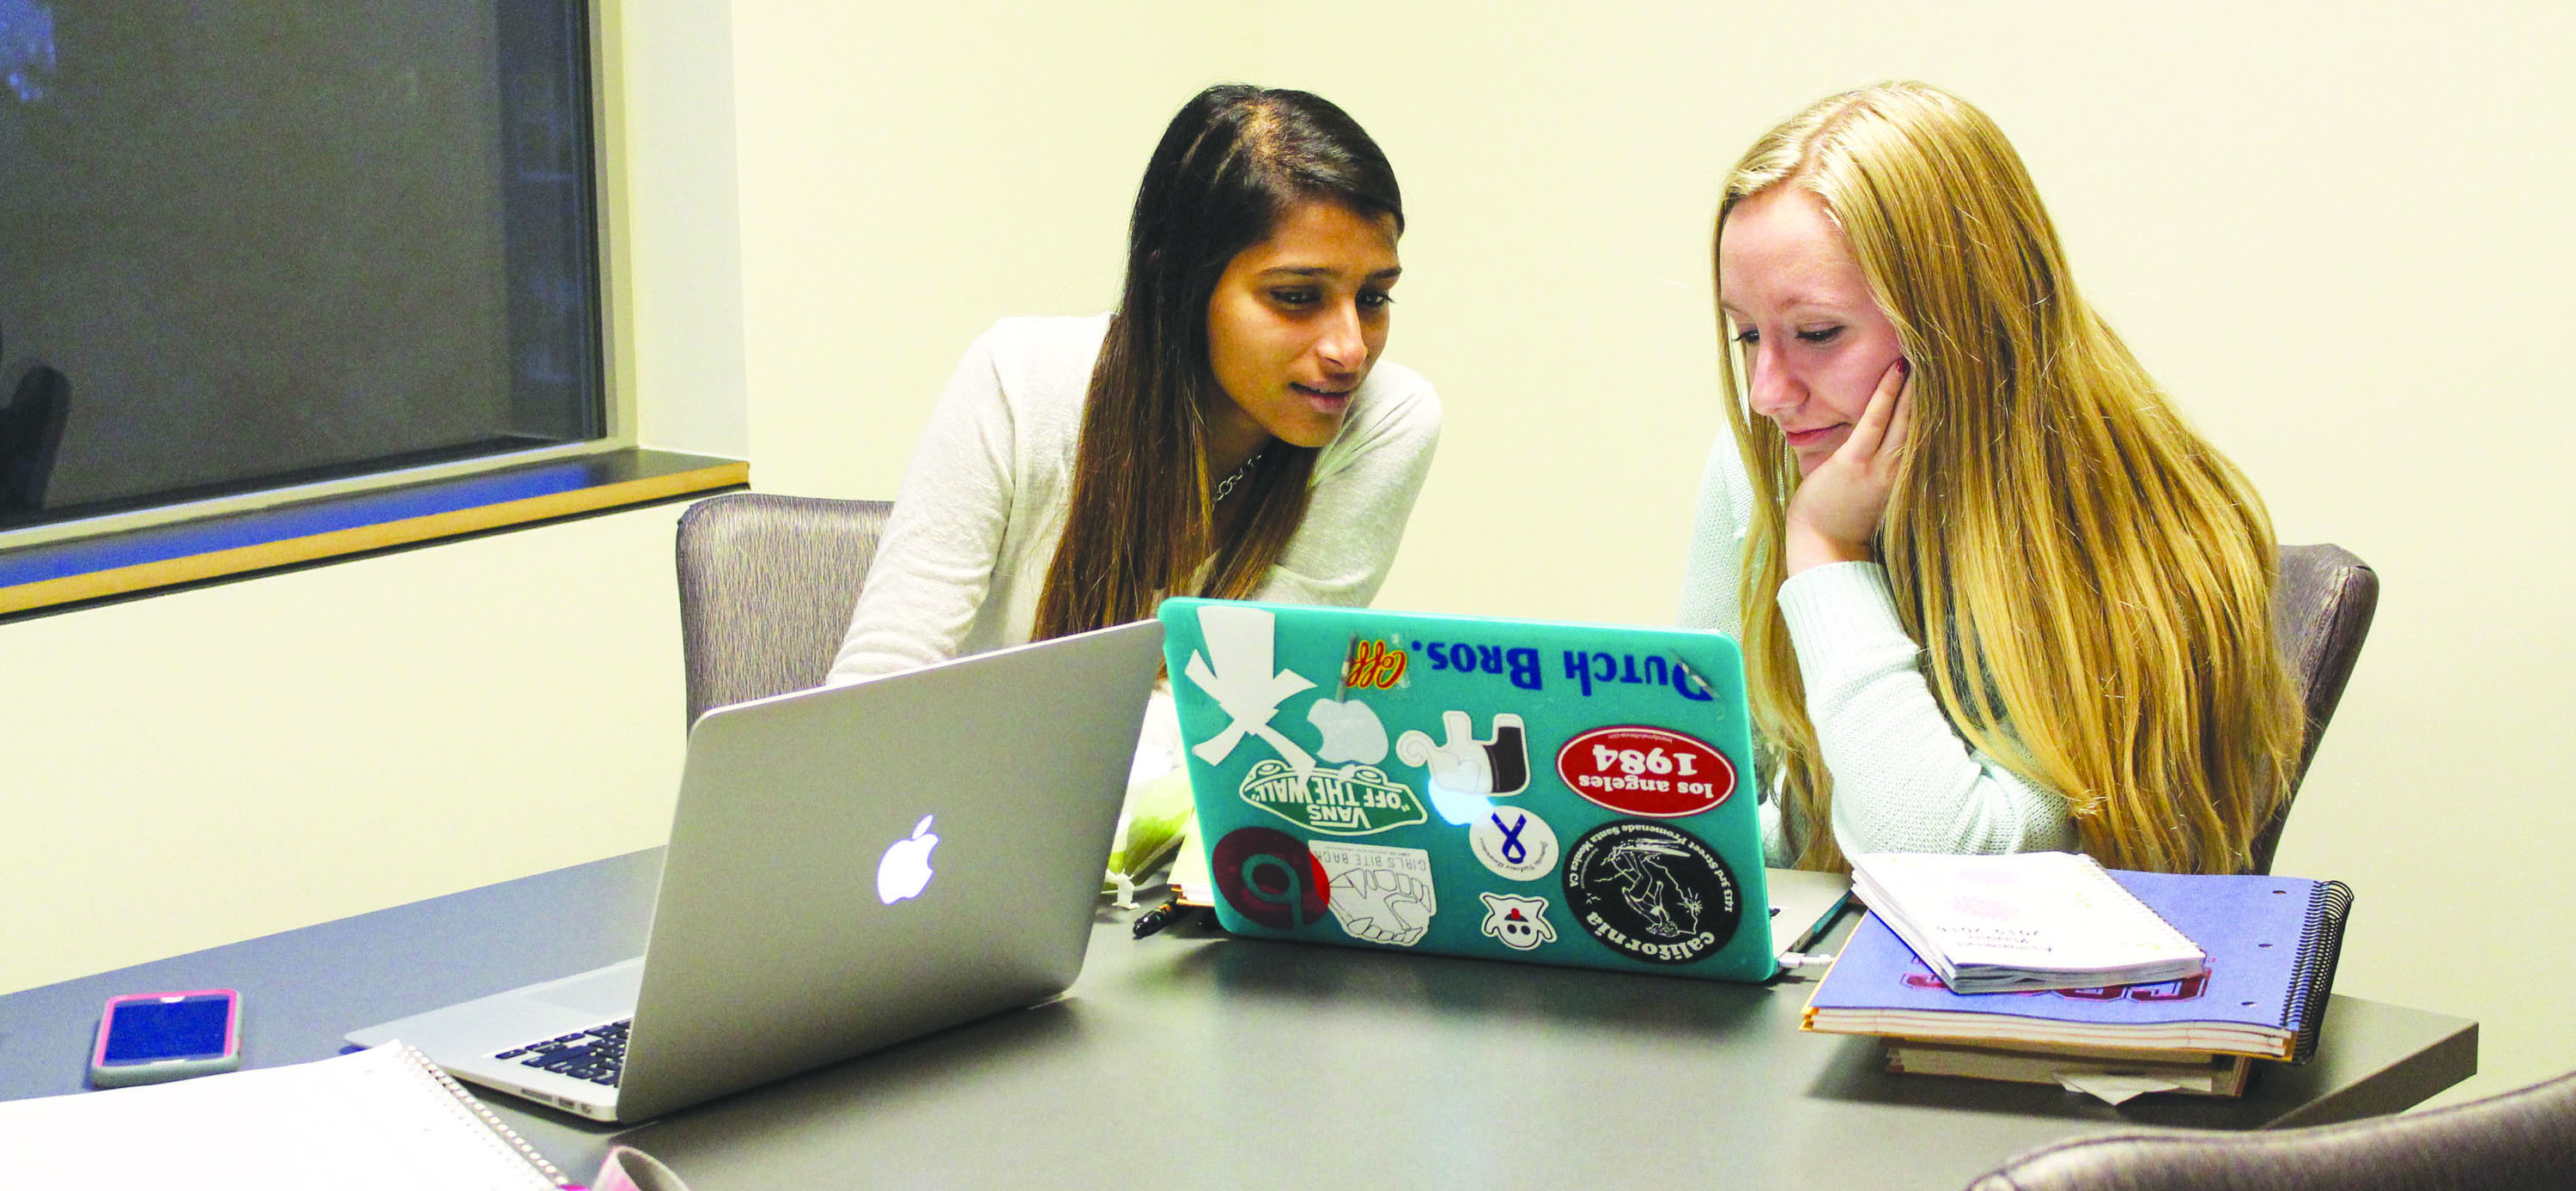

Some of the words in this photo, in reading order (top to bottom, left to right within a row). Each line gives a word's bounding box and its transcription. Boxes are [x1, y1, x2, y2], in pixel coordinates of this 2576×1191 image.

[1592, 744, 1698, 776] 1984
[1310, 776, 1359, 807] THE
[1578, 775, 1670, 794] angeles
[1677, 782, 1715, 799] los
[1307, 804, 1370, 829] VANS
[1590, 827, 1620, 844] Santa
[1621, 824, 1688, 846] Promenade
[1314, 851, 1348, 866] BACK
[1354, 854, 1382, 869] BITE
[1388, 857, 1426, 872] GIRLS
[1570, 840, 1593, 872] Monica
[1687, 841, 1719, 869] Street
[1569, 873, 1580, 888] CA
[1714, 869, 1731, 887] 3rd
[1586, 910, 1715, 961] california
